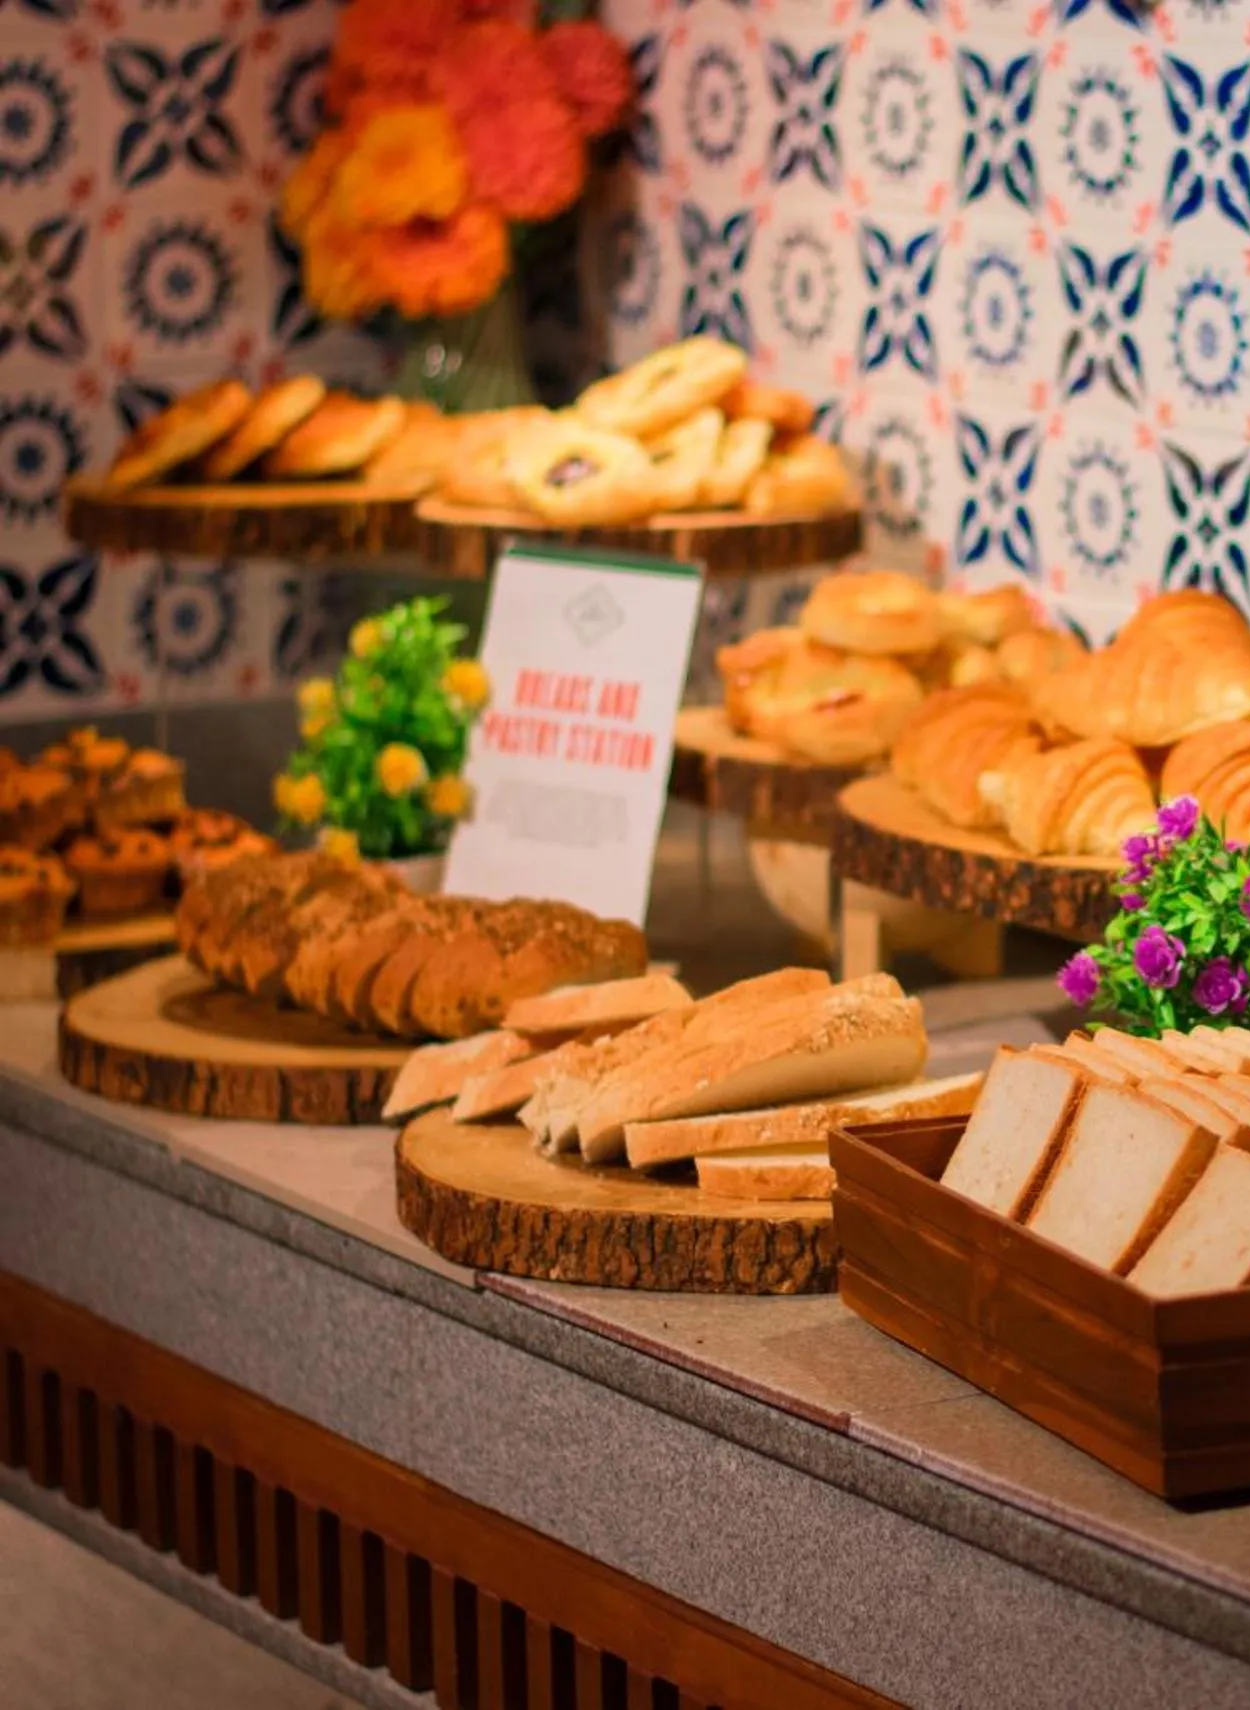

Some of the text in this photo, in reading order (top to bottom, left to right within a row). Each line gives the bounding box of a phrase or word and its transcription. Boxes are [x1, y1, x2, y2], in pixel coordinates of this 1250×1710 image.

[597, 680, 640, 720] AND
[483, 711, 655, 771] PASTRY STATION
